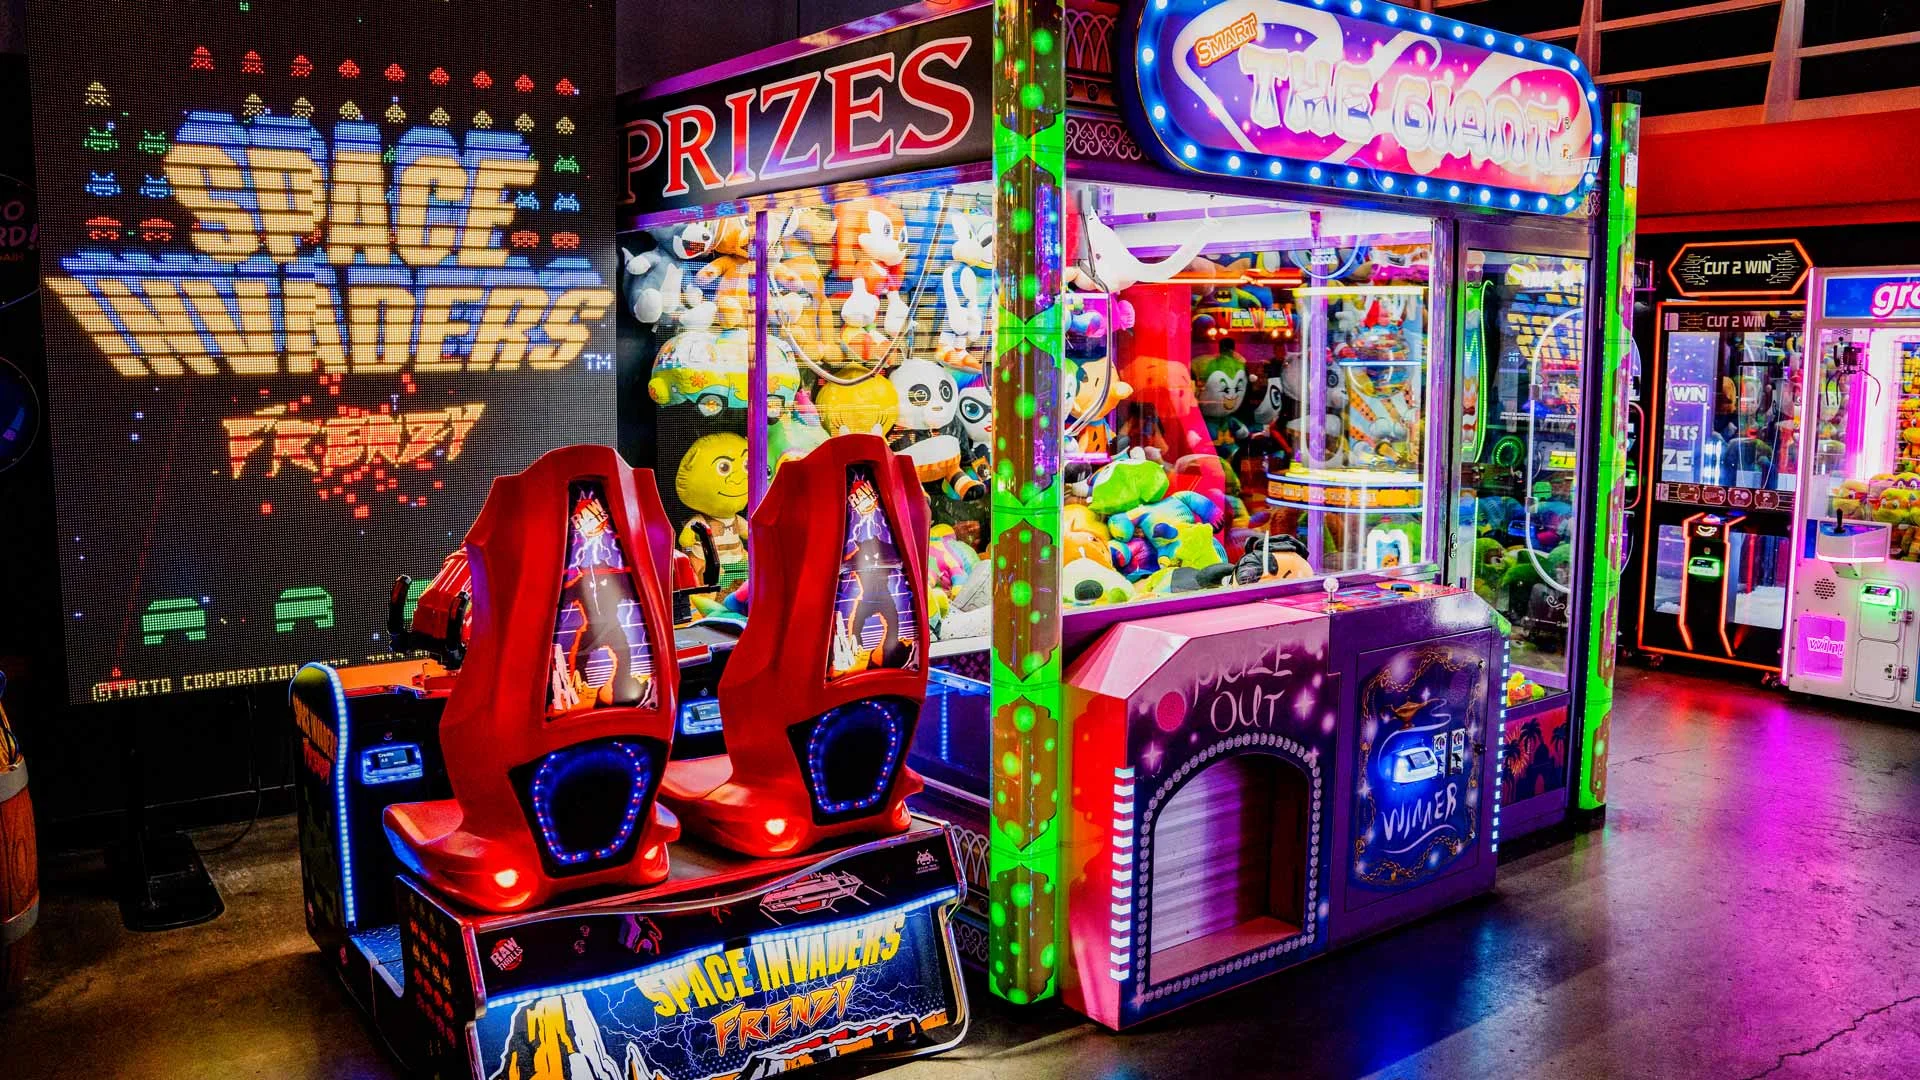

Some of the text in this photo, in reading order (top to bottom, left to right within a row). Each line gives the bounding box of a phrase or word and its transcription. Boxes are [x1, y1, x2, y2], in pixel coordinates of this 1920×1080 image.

[1195, 13, 1259, 68] SMART
[616, 35, 975, 206] PRIZES
[1238, 44, 1566, 172] THE GIANT
[163, 118, 540, 267] SPACE
[1704, 259, 1772, 275] CUT 2 WIN
[44, 270, 615, 376] INVADERS
[1706, 315, 1766, 328] CUT 2 WIN
[583, 353, 612, 371] TM
[1672, 384, 1708, 404] WIN
[222, 402, 487, 480] FRENZY
[1807, 636, 1845, 658] win!
[1210, 684, 1285, 733] OUT
[490, 937, 519, 967] RAW
[497, 946, 524, 972] THRILLS
[634, 912, 905, 1018] SPACE INVADERS
[711, 975, 857, 1057] FRENZY
